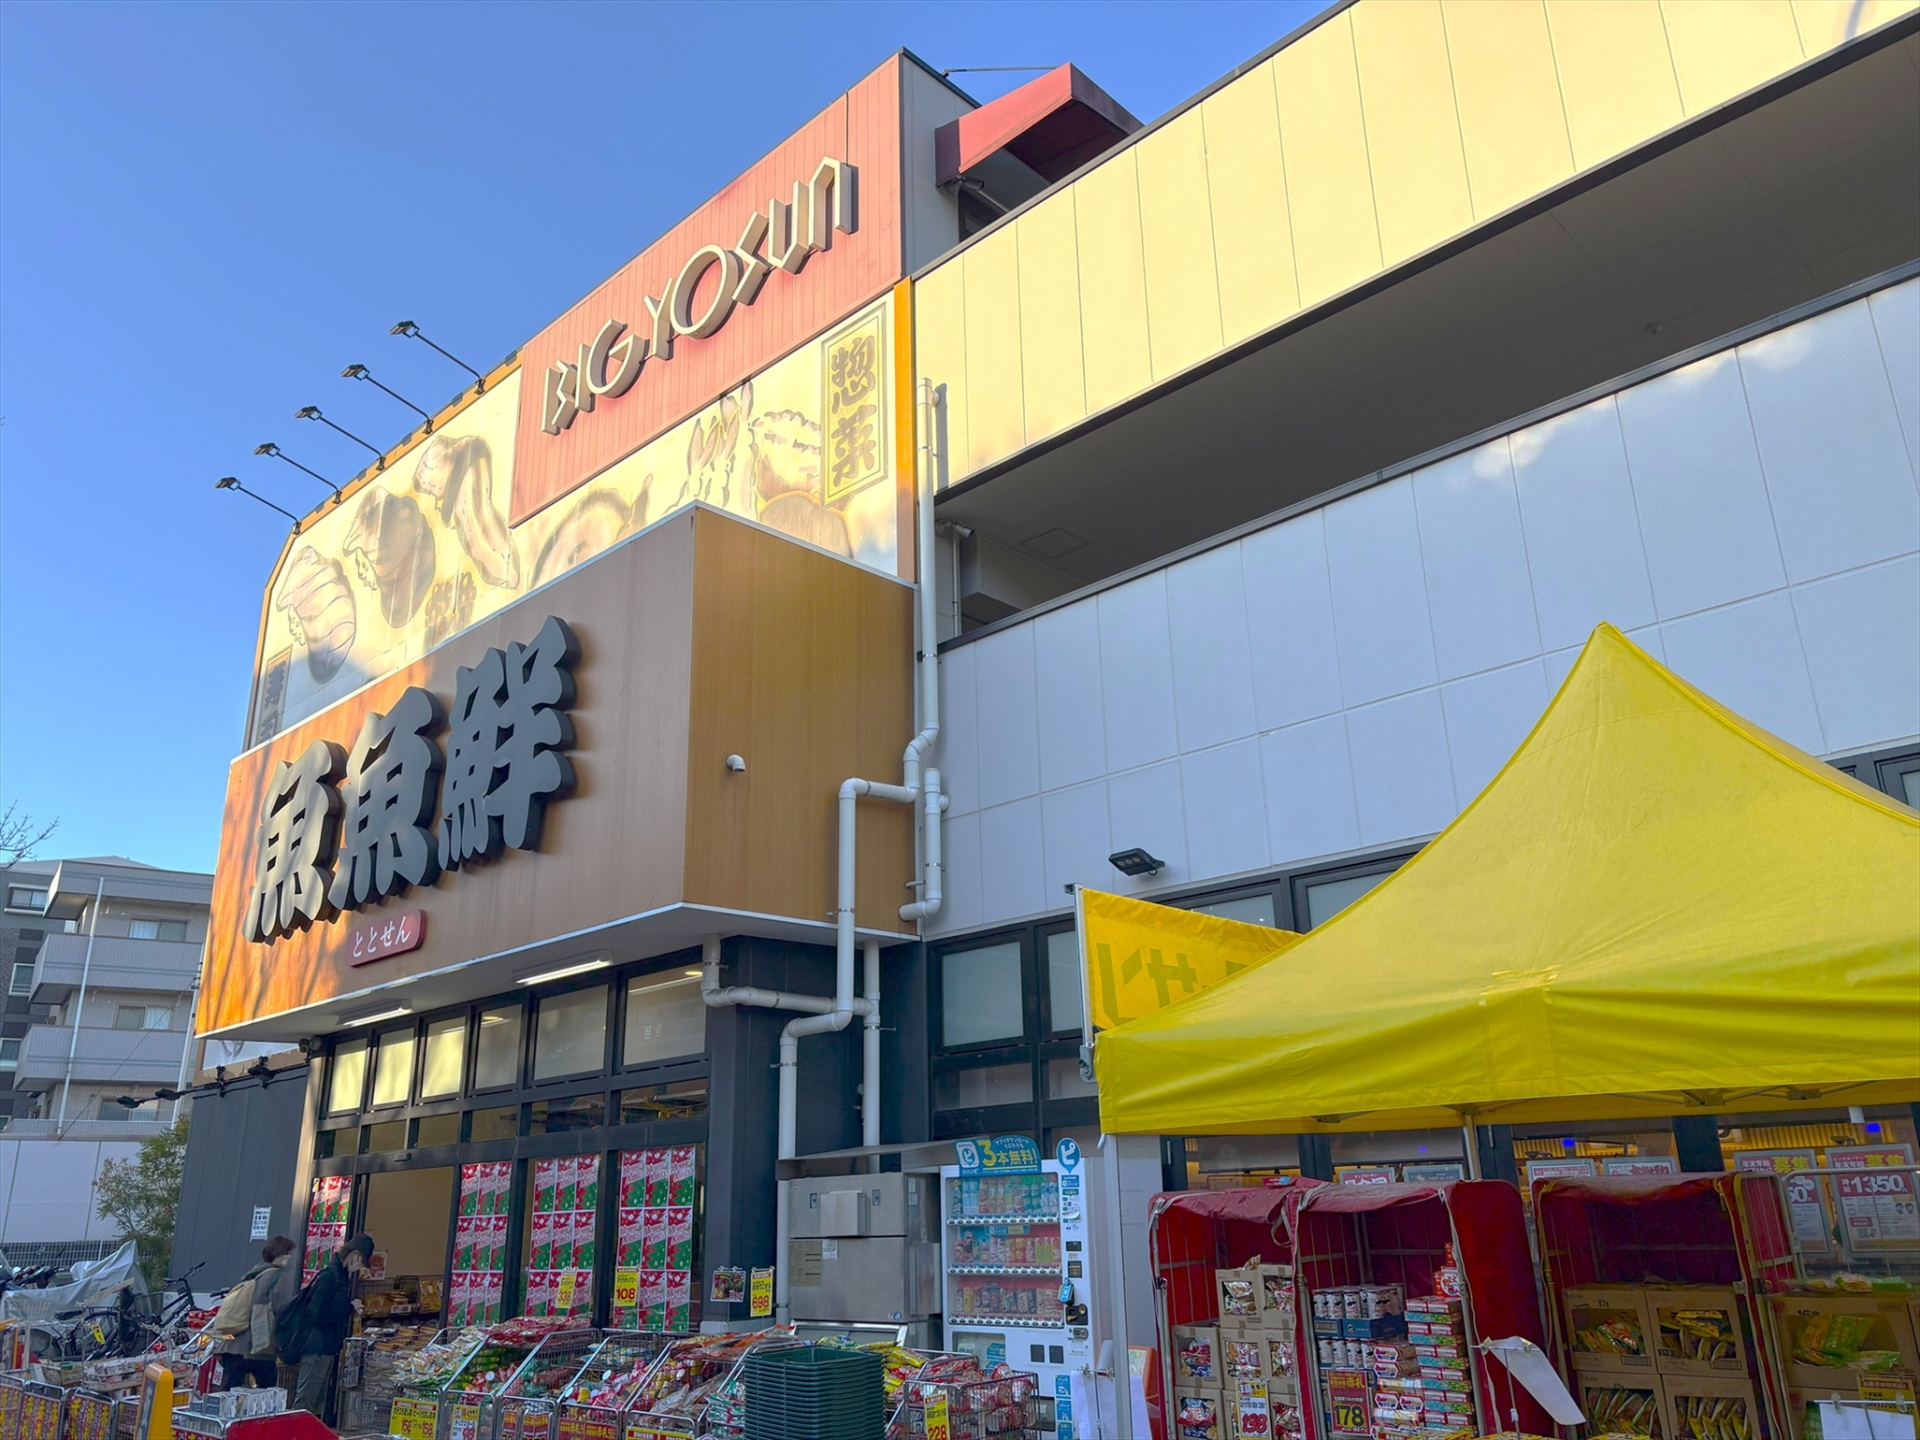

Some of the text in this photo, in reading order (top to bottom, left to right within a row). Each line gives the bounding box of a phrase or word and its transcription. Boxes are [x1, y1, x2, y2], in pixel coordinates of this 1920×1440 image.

[831, 335, 877, 487] 惣菜
[242, 615, 580, 946] 魚魚鮮
[352, 915, 412, 958] ととせん
[1060, 1142, 1076, 1165] ピ
[616, 1288, 636, 1300] 108
[752, 1295, 770, 1309] 698
[1242, 1413, 1267, 1434] 138
[1336, 1405, 1364, 1427] 178
